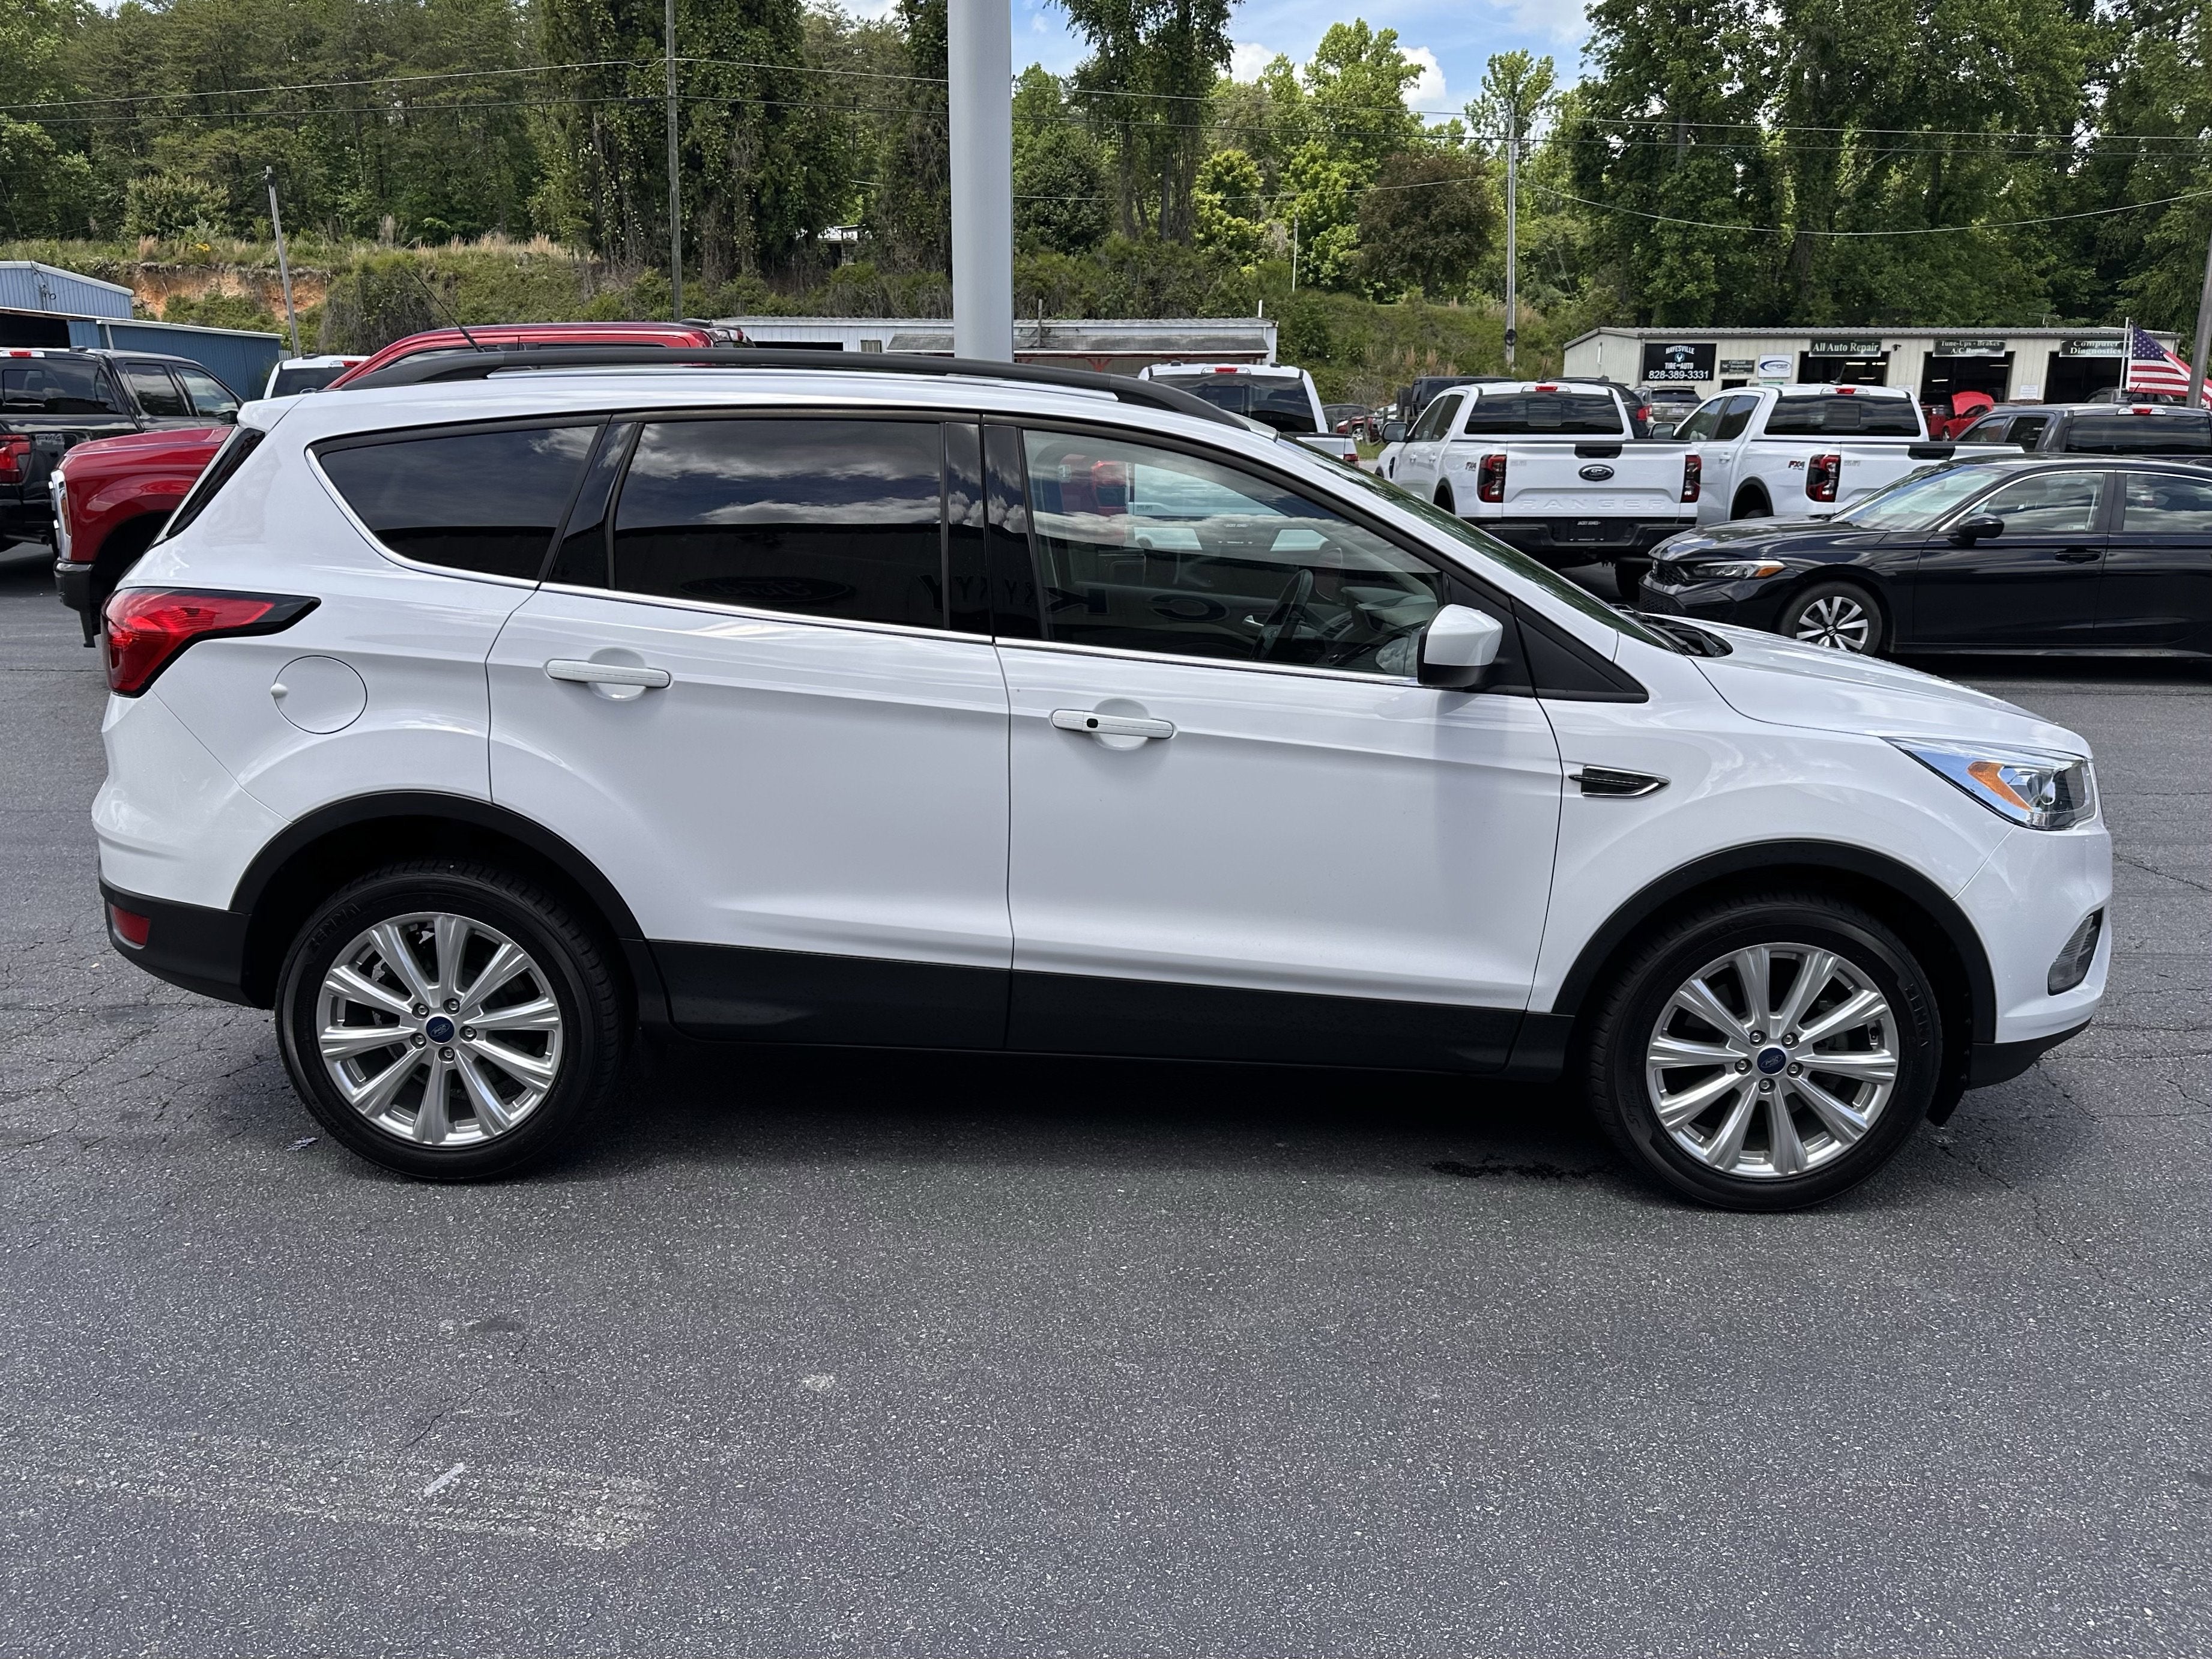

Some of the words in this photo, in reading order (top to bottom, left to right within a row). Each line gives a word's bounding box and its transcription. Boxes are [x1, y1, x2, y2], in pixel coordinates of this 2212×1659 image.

[1665, 345, 1695, 354] HAYESVILLE
[1813, 342, 1825, 352] All
[1826, 343, 1848, 352] Auto
[1849, 342, 1879, 353] Repair
[1648, 370, 1708, 379] 828-389-3331
[1520, 499, 1666, 509] RANGER
